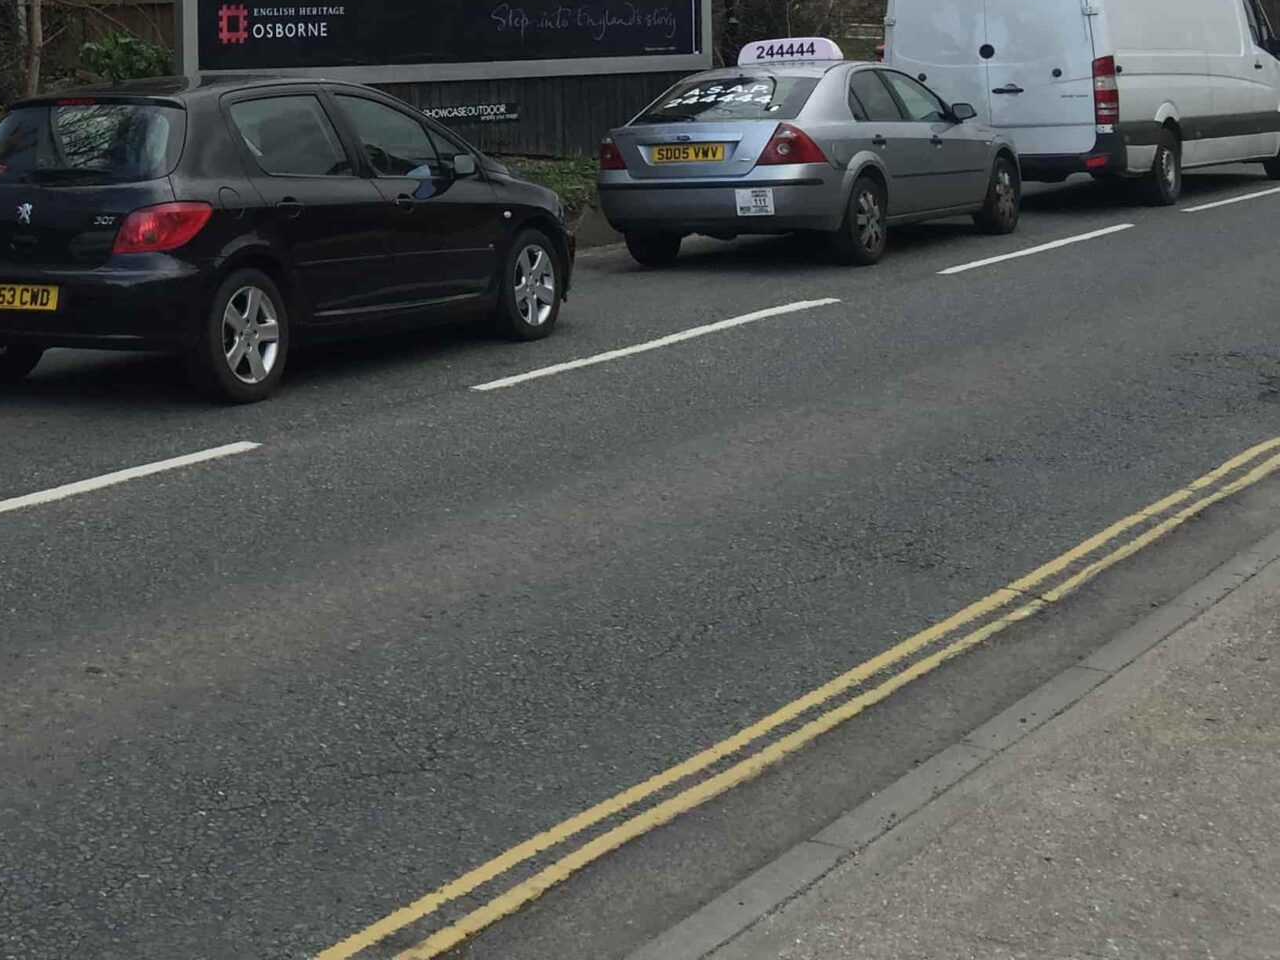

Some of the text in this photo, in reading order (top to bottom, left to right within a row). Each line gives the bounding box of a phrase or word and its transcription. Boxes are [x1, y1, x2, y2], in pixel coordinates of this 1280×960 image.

[253, 6, 345, 16] ENGLISH HERITAGE
[491, 3, 532, 40] Step
[538, 6, 571, 29] into
[646, 7, 676, 38] story
[253, 22, 328, 38] OSBORNE
[756, 41, 816, 59] 244444
[657, 145, 718, 161] SD05 VWV
[94, 215, 116, 225] 307
[19, 288, 50, 306] CWD
